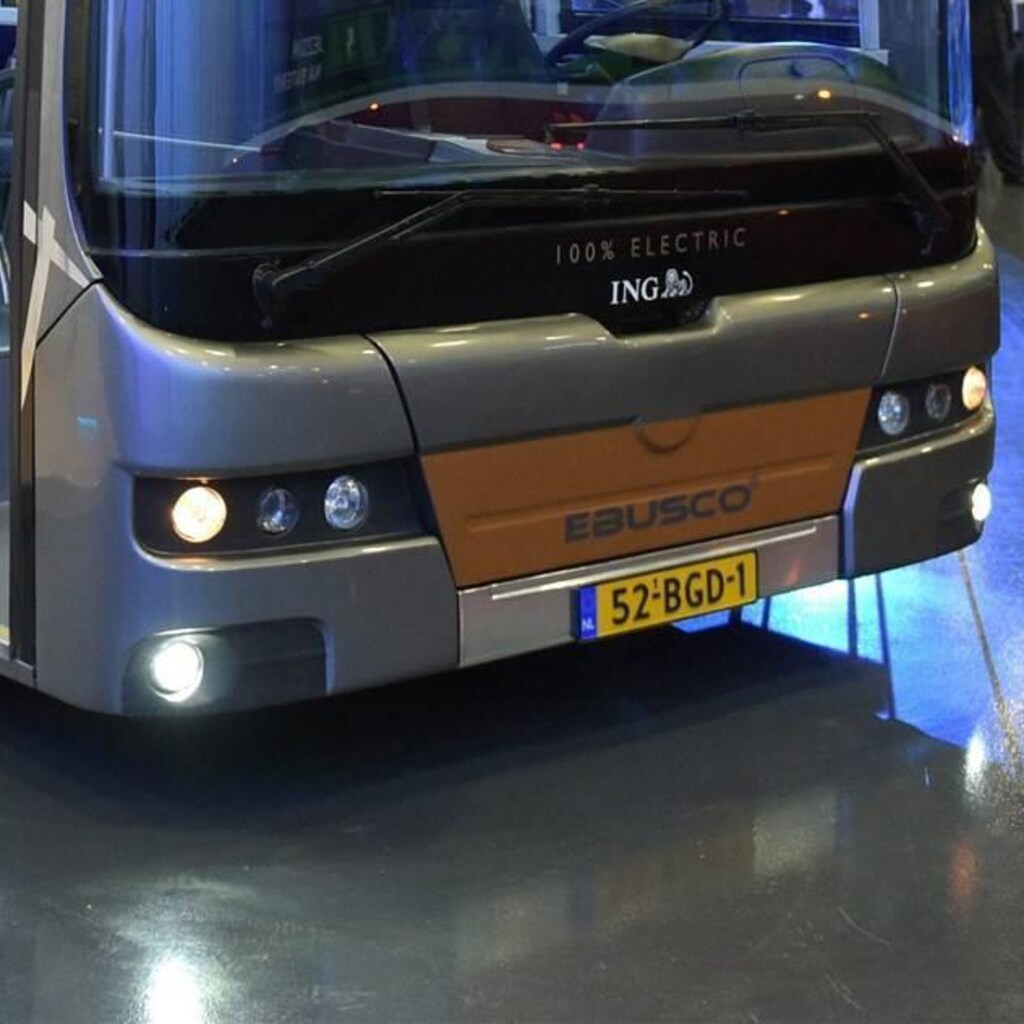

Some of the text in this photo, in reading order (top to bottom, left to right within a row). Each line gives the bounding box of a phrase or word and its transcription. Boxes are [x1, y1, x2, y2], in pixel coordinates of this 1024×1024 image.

[556, 228, 746, 265] 100% ELECTRIC
[610, 276, 659, 305] ING
[565, 484, 752, 543] EBUSCO
[612, 562, 746, 626] 52-BGD-1
[582, 618, 595, 632] NL
